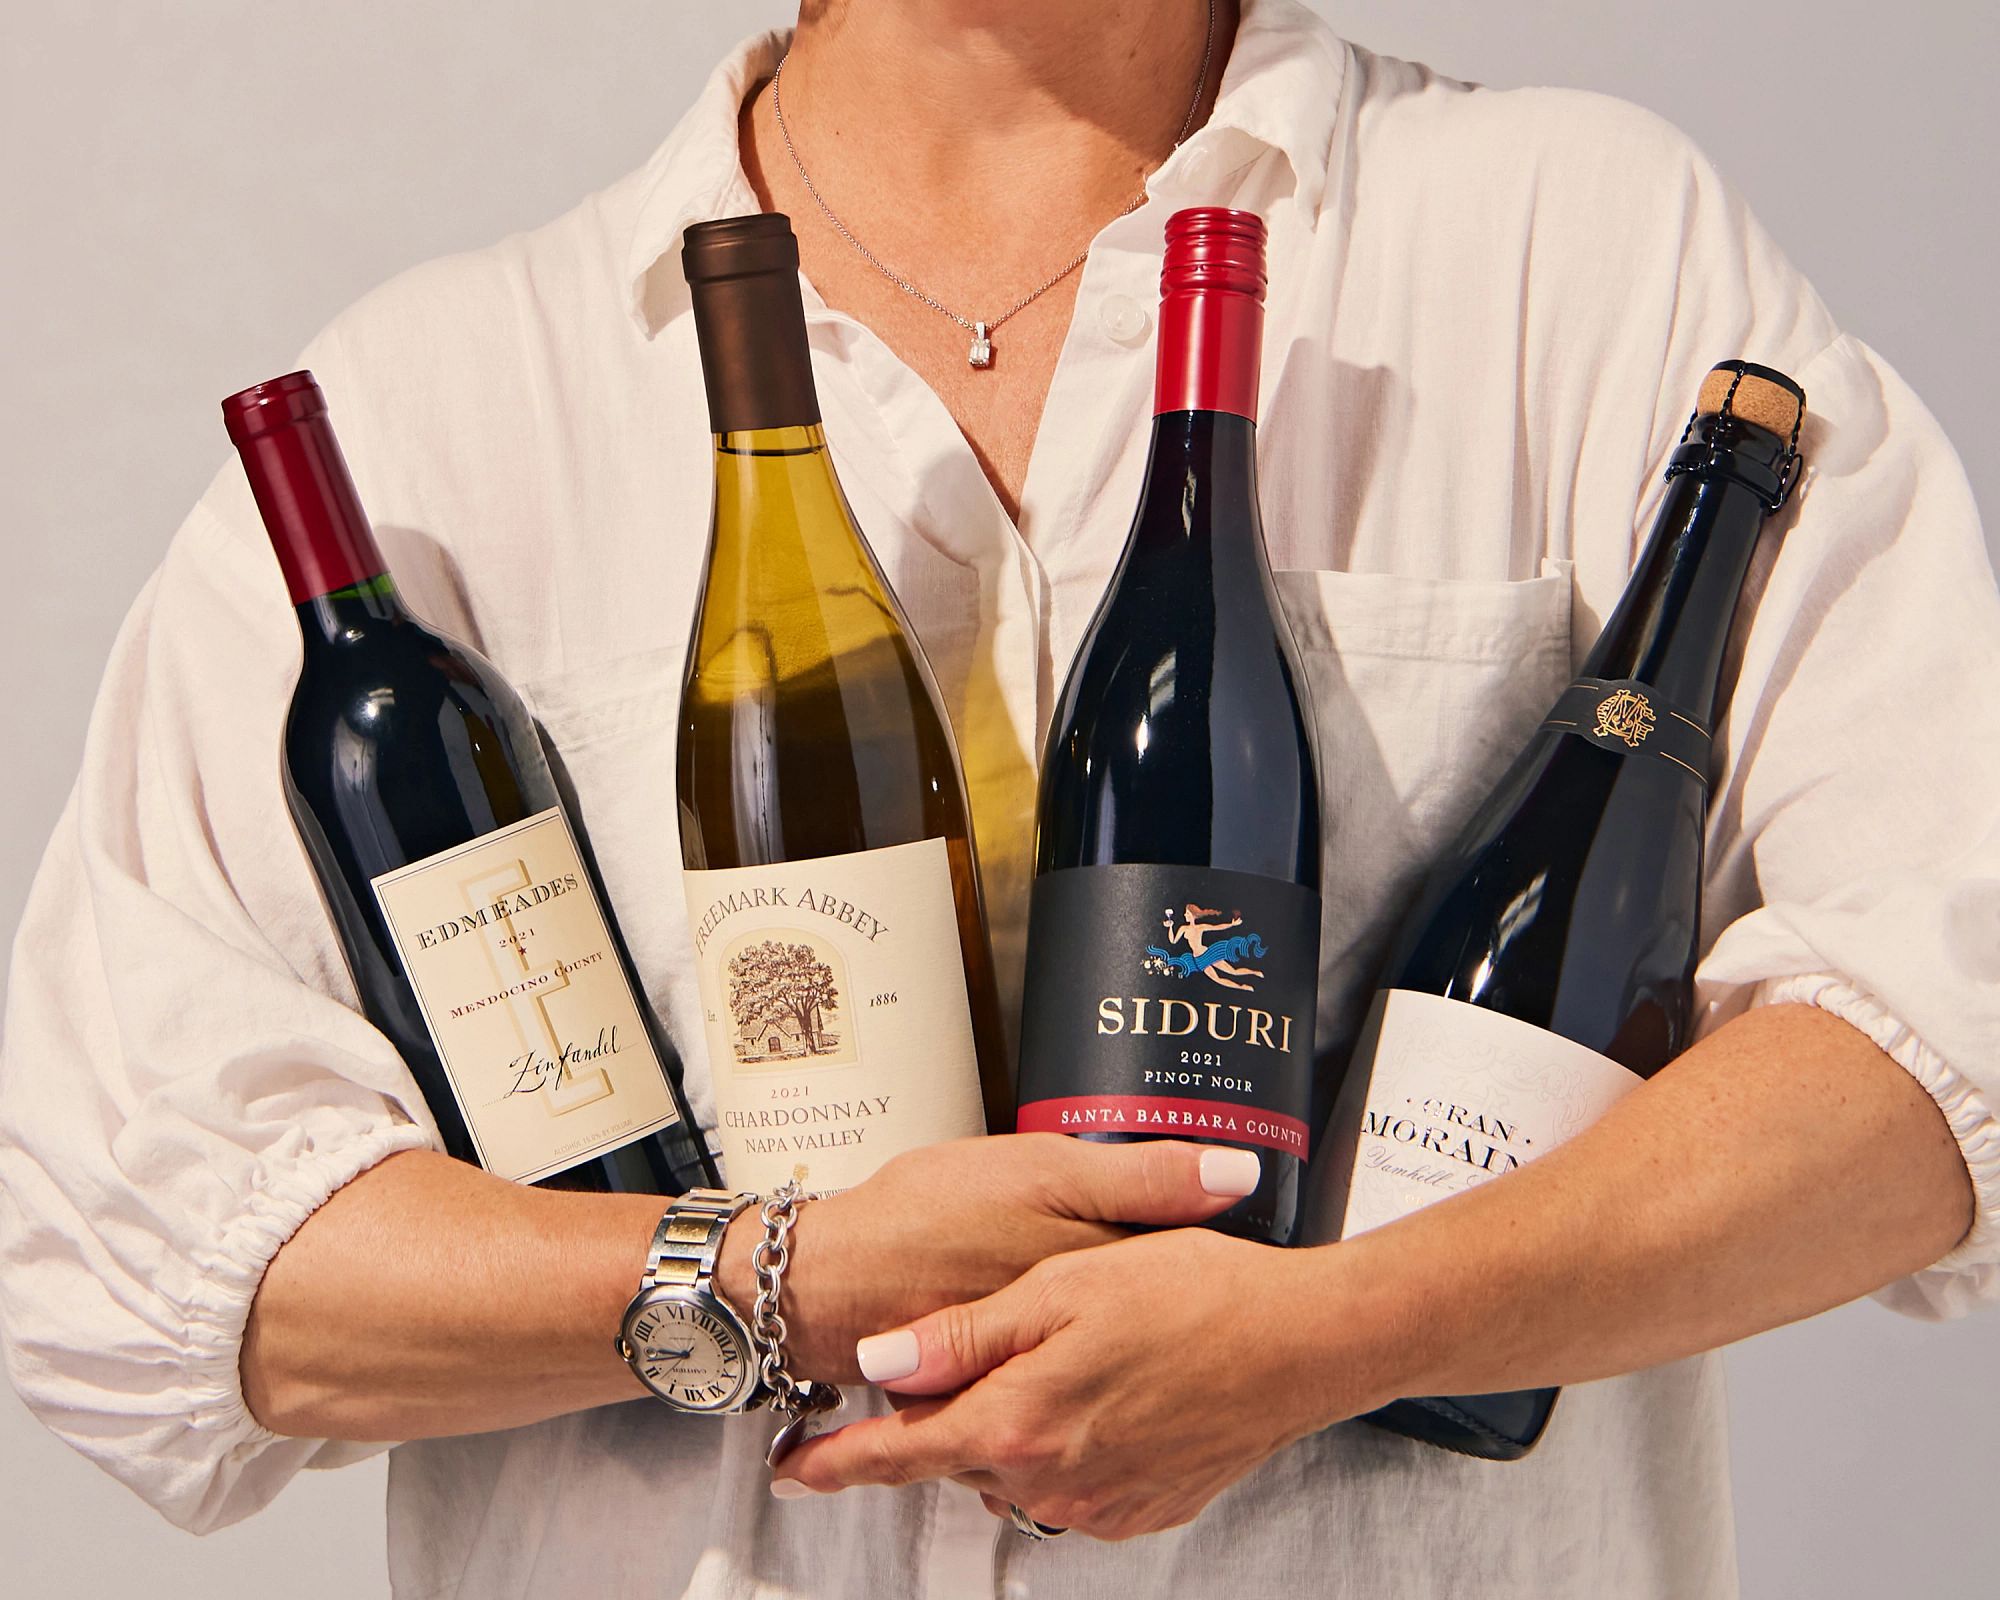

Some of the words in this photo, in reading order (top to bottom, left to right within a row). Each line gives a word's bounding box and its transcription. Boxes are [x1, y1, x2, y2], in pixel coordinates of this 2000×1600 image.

[415, 873, 579, 951] EDMEADES
[694, 887, 789, 957] FREEMARK
[797, 888, 890, 942] ABBEY
[499, 928, 535, 948] 2021
[449, 974, 548, 1019] MENDOCINO
[554, 951, 604, 978] COUNTY
[870, 992, 898, 1008] 1886
[1097, 997, 1293, 1053] SIDURI
[503, 1025, 621, 1099] Zinfandel
[1180, 1051, 1222, 1067] 2021
[771, 1085, 809, 1099] 2021
[1144, 1070, 1203, 1086] PINOT
[1211, 1075, 1253, 1093] NOIR
[725, 1096, 892, 1128] CHARDONNAY
[1061, 1109, 1126, 1124] SANTA
[1136, 1109, 1238, 1131] BARBARA
[1246, 1120, 1303, 1146] COUNTY
[1423, 1098, 1518, 1144] GRAN
[745, 1137, 788, 1153] NAPA
[793, 1128, 866, 1149] VALLEY
